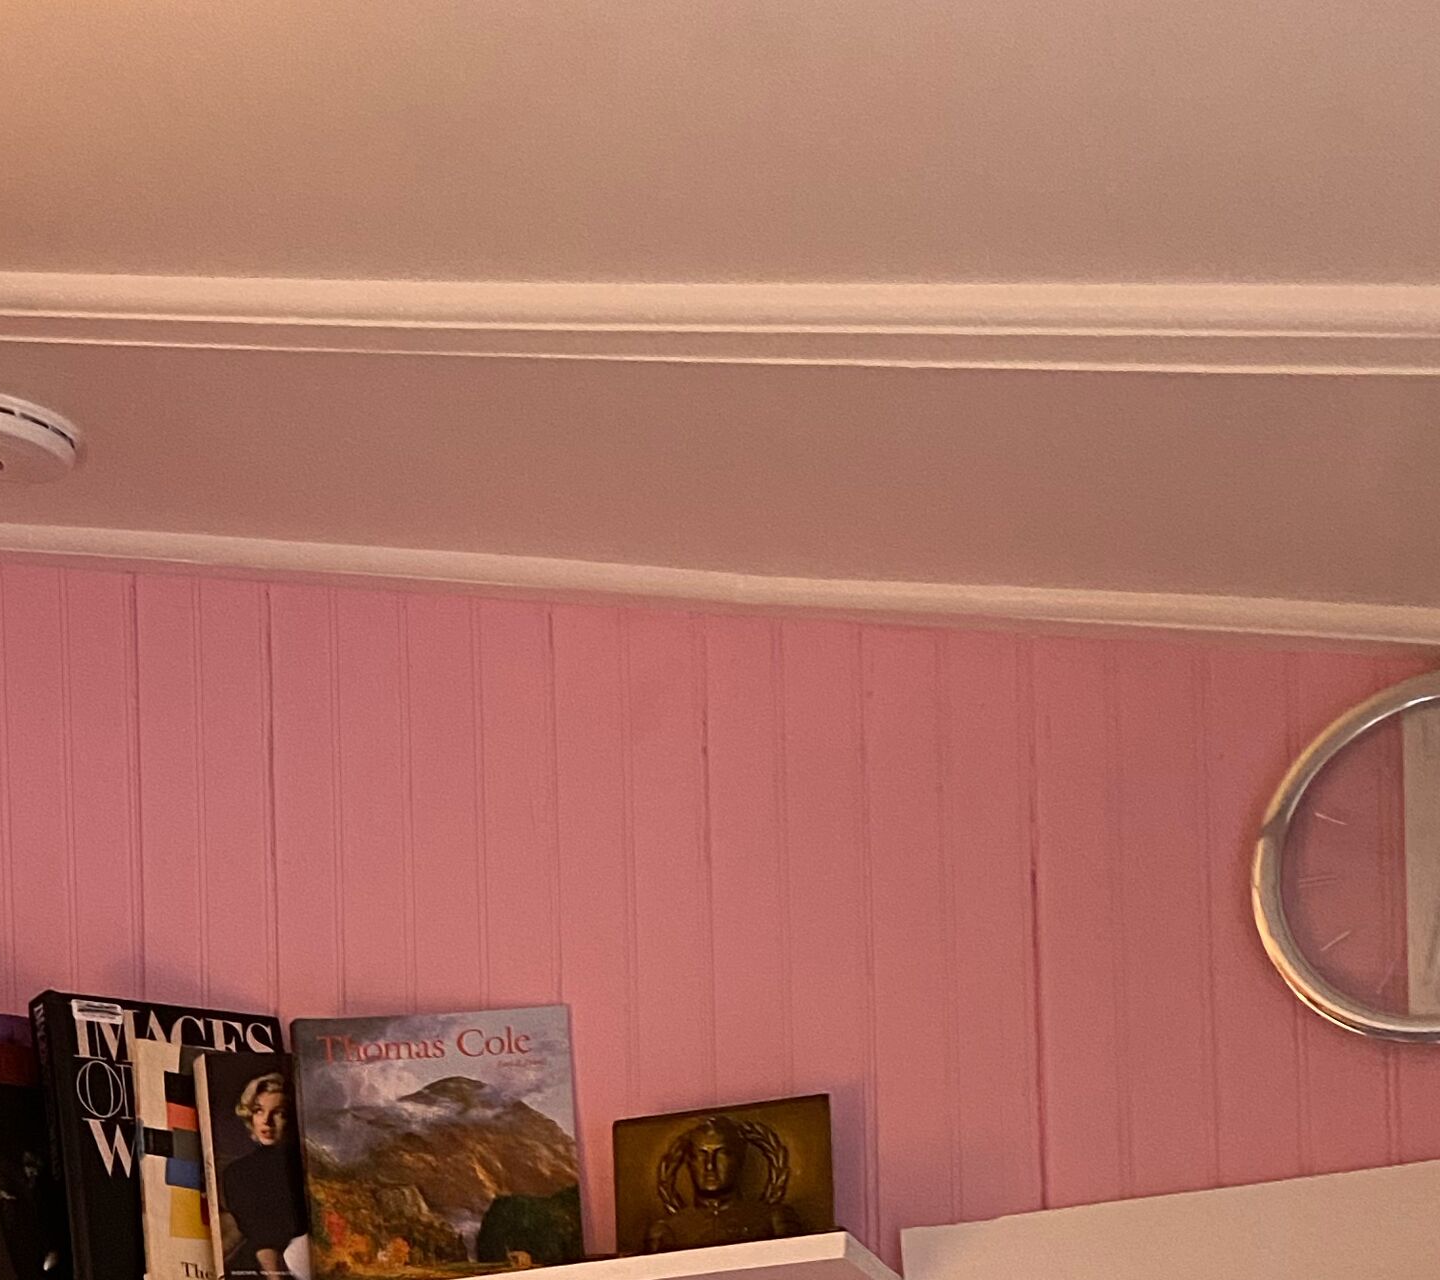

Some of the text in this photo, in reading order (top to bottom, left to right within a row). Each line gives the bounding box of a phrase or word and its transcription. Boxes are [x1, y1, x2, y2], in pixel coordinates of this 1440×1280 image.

[316, 1025, 532, 1066] Thomas Cole
[181, 1260, 214, 1280] The
